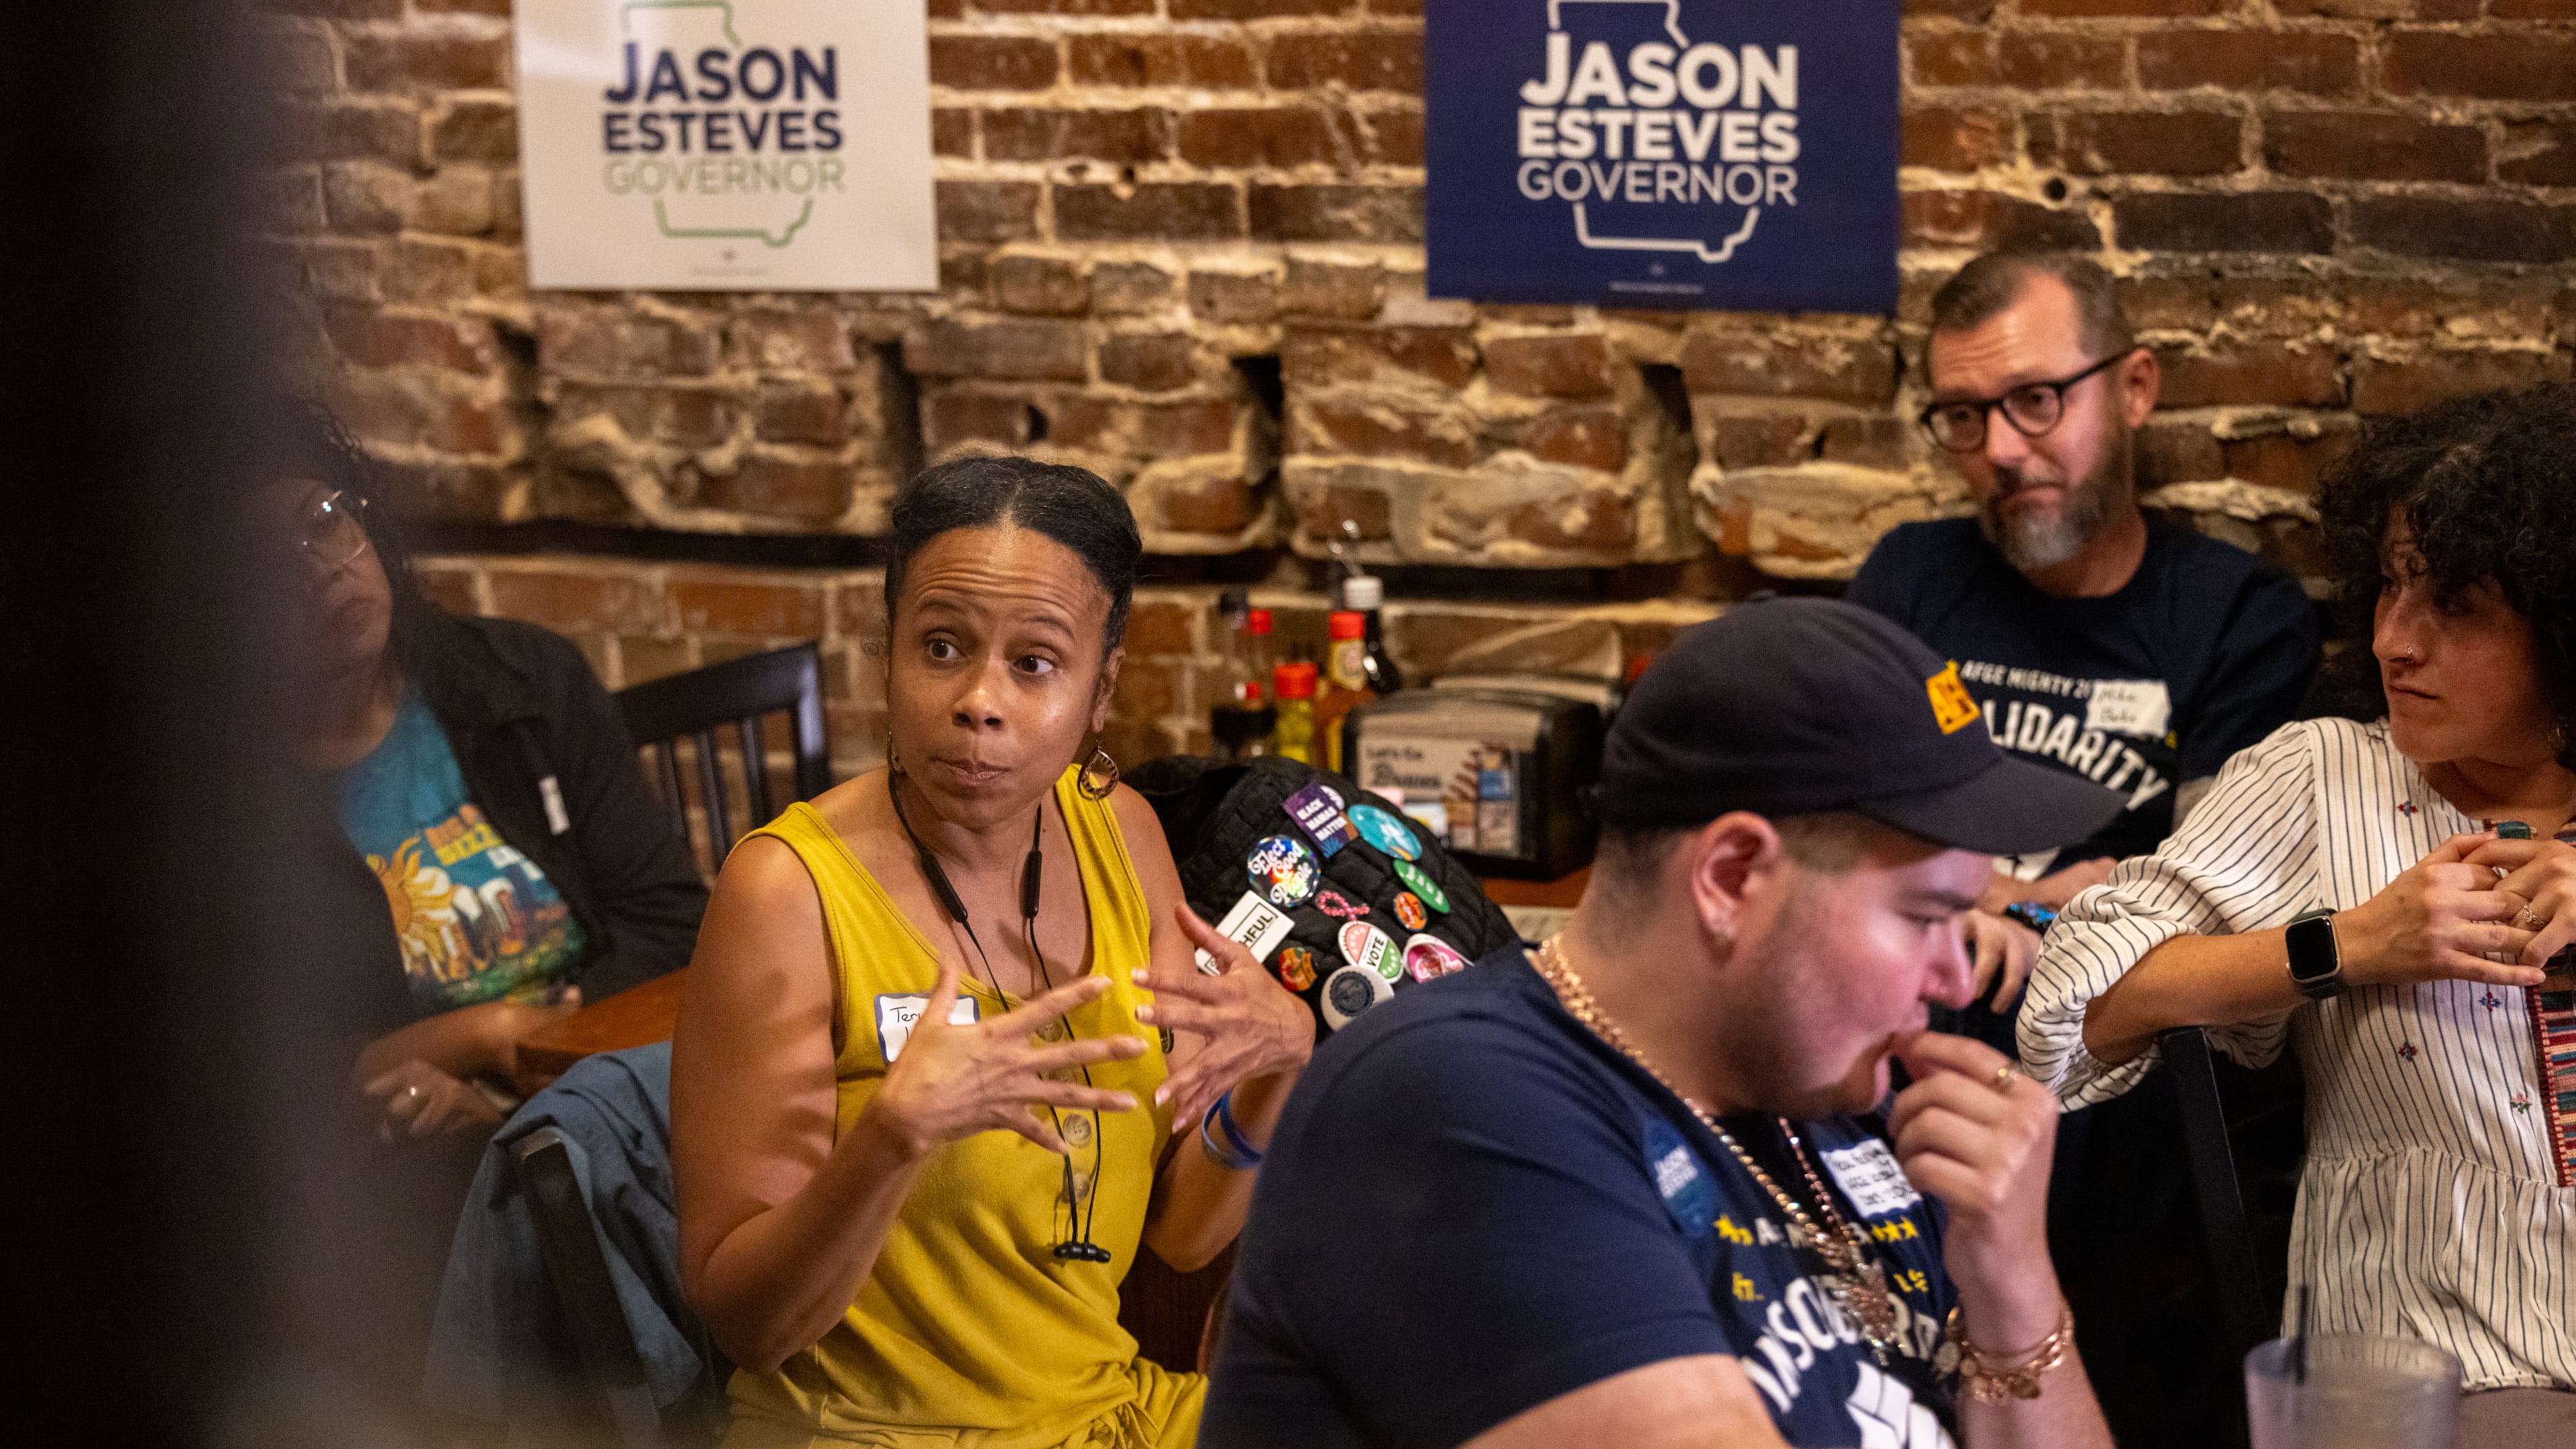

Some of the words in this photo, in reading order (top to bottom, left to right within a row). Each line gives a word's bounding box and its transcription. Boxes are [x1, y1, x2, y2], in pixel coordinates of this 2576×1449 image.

[604, 42, 837, 104] JASON
[1519, 32, 1799, 109] JASON
[604, 110, 844, 153] ESTEVES
[1517, 107, 1801, 164] ESTEVES
[604, 156, 846, 195] GOVERNOR
[1517, 160, 1798, 207] GOVERNOR
[1366, 936, 1385, 967] VOTE
